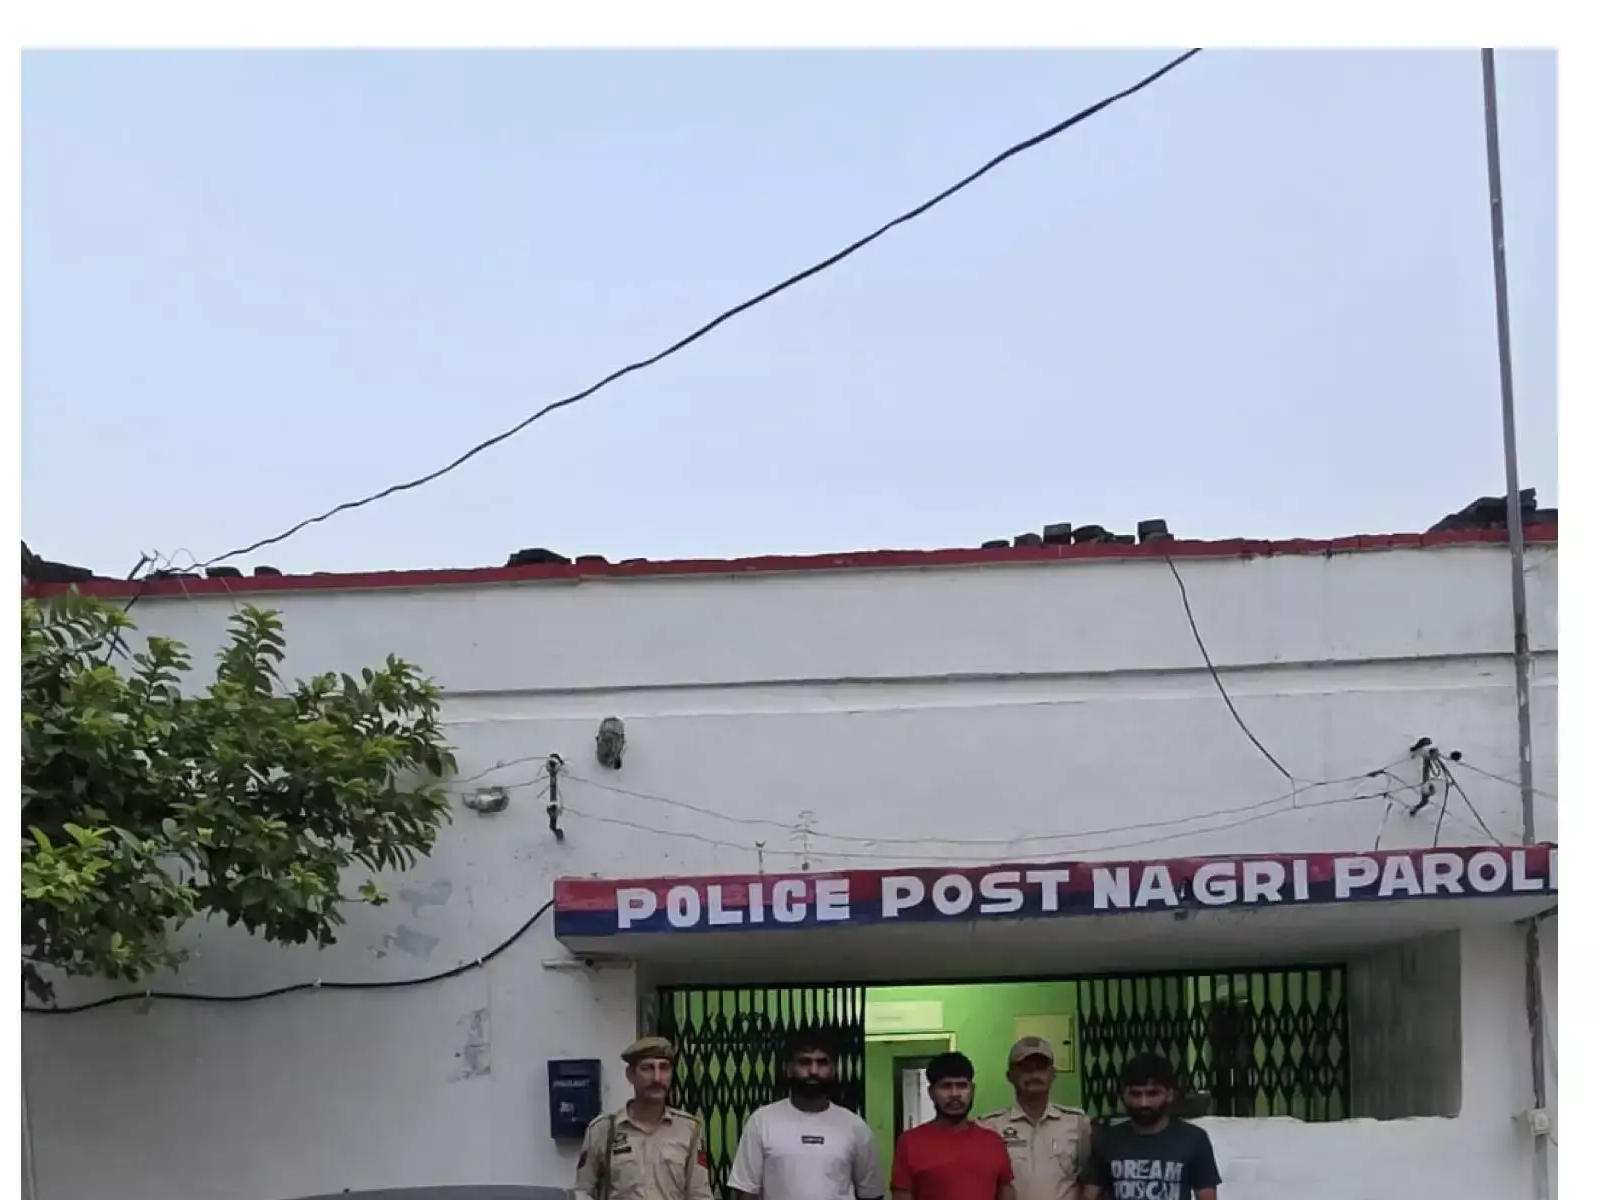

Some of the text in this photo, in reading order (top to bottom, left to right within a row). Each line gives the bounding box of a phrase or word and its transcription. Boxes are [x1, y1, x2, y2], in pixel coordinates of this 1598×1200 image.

[616, 878, 851, 928] POLICE
[881, 870, 1070, 917] POST
[1111, 1159, 1183, 1181] DREAM
